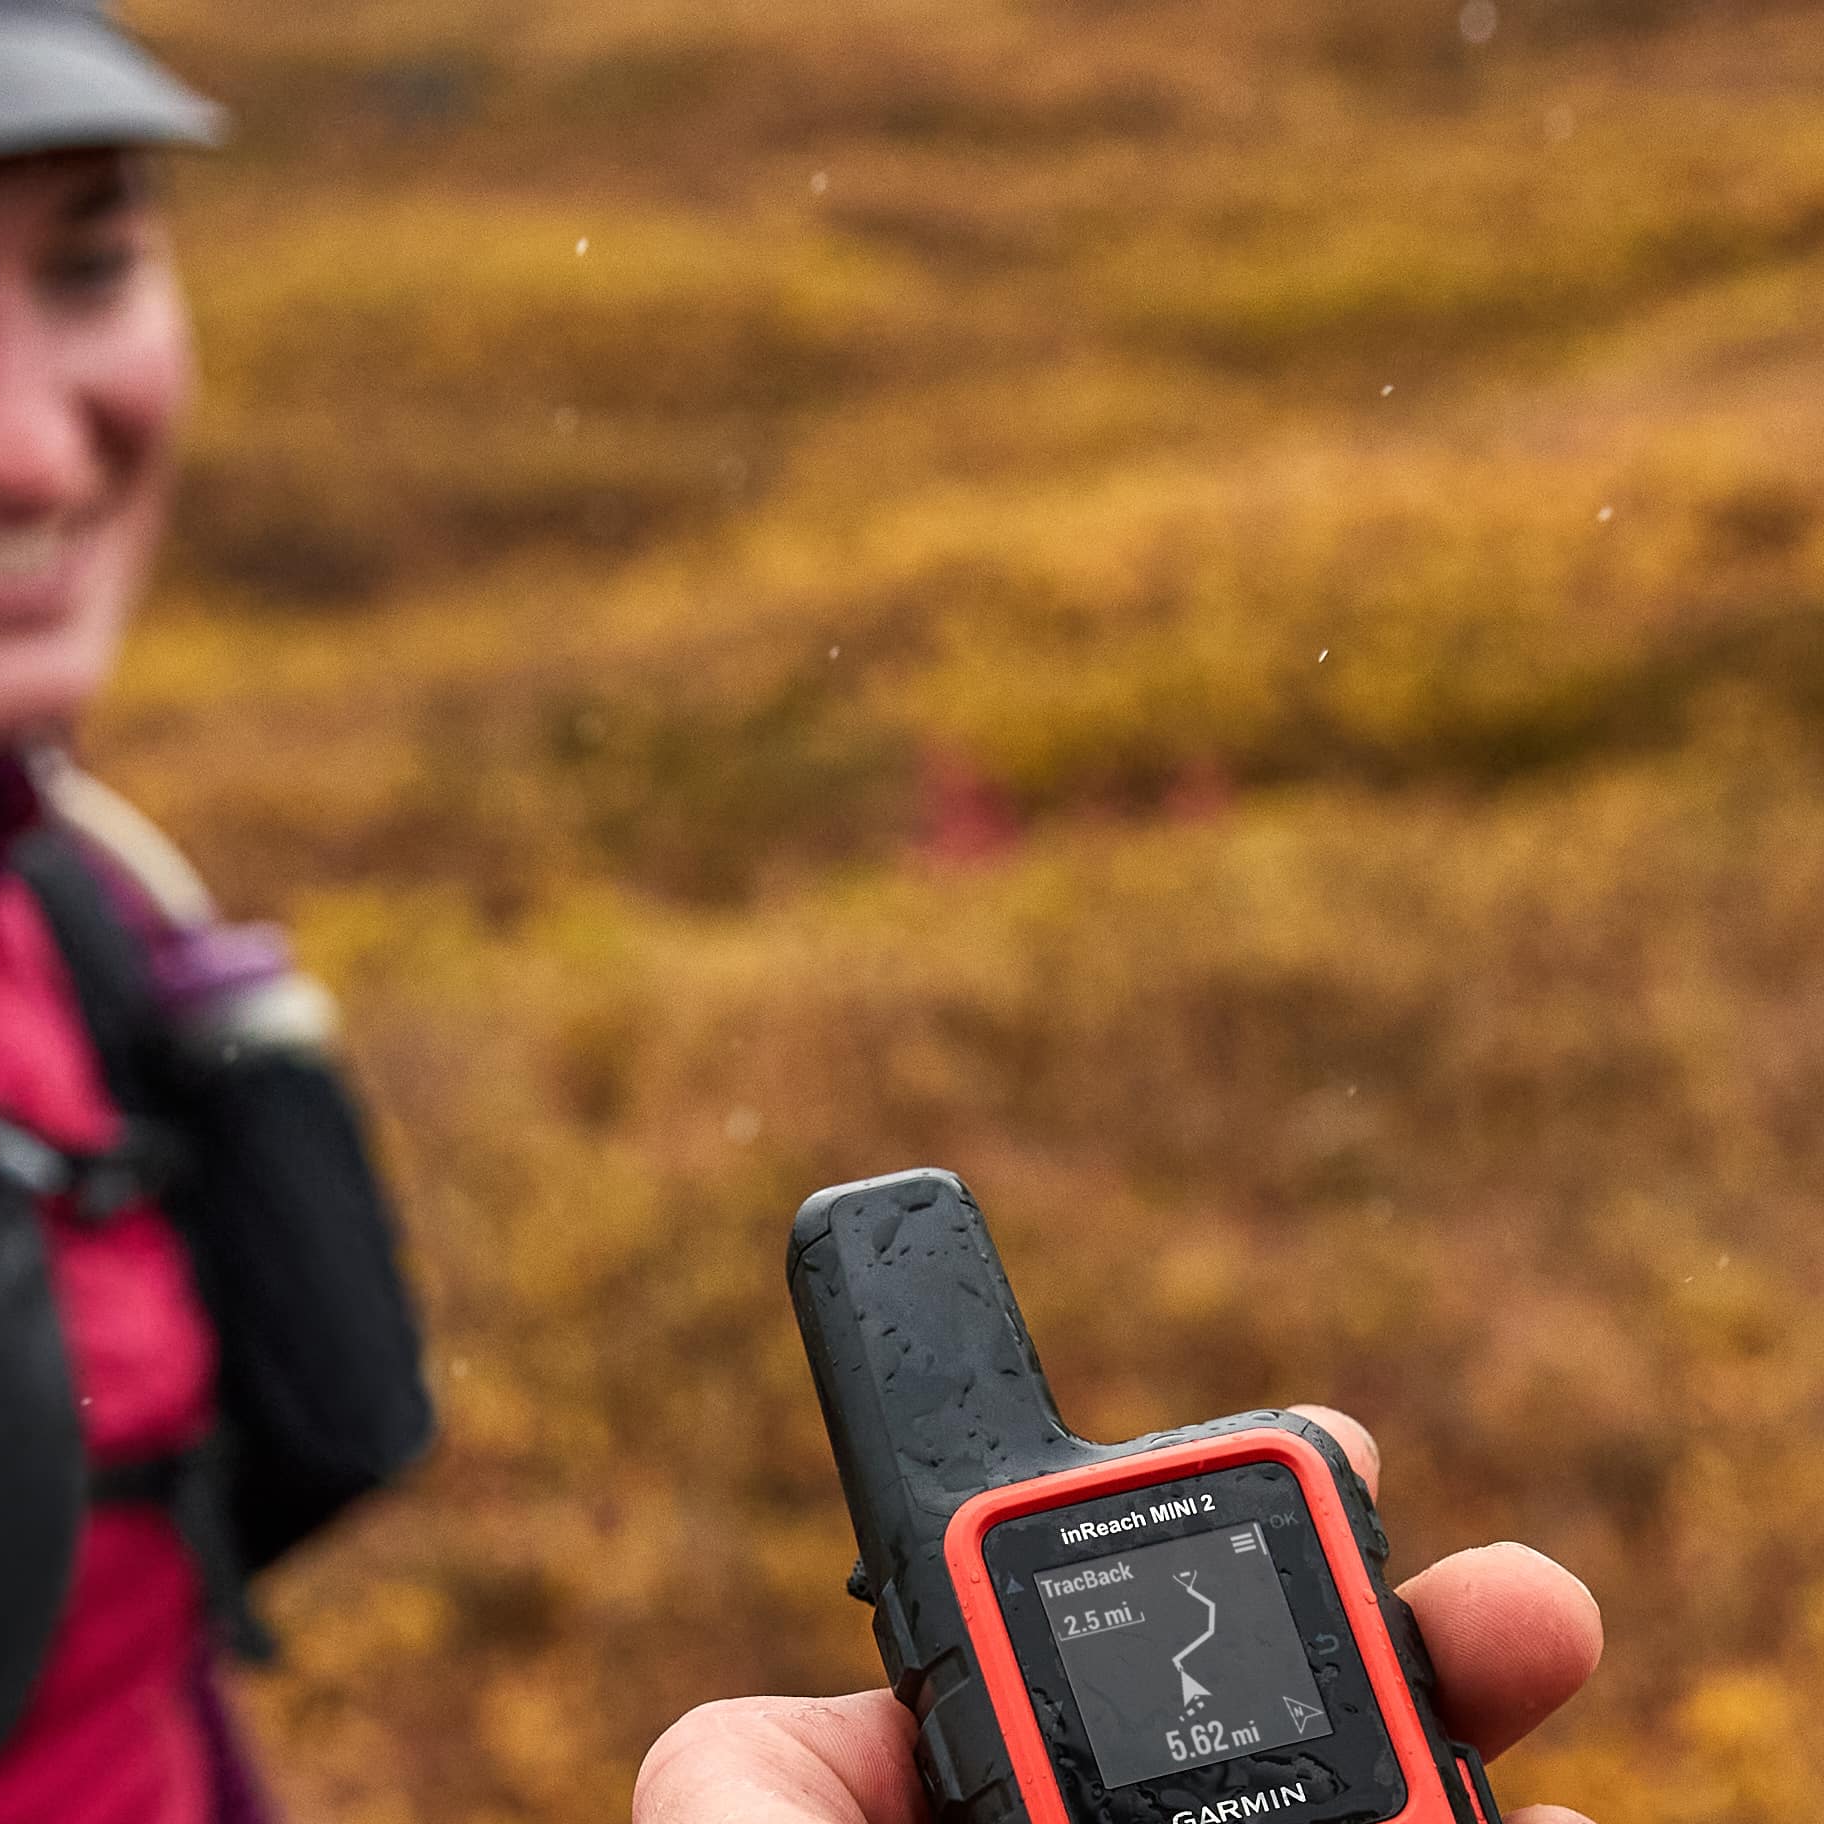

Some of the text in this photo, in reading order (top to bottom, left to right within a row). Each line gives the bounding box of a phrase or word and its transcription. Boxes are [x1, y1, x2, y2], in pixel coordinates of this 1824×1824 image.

[1060, 1494, 1216, 1545] inReach MINI 2
[1269, 1511, 1299, 1529] OK
[1040, 1561, 1134, 1599] TracBack
[1063, 1601, 1133, 1636] 2.5 mi
[1293, 1705, 1305, 1718] N
[1165, 1719, 1261, 1761] 5.62 mi
